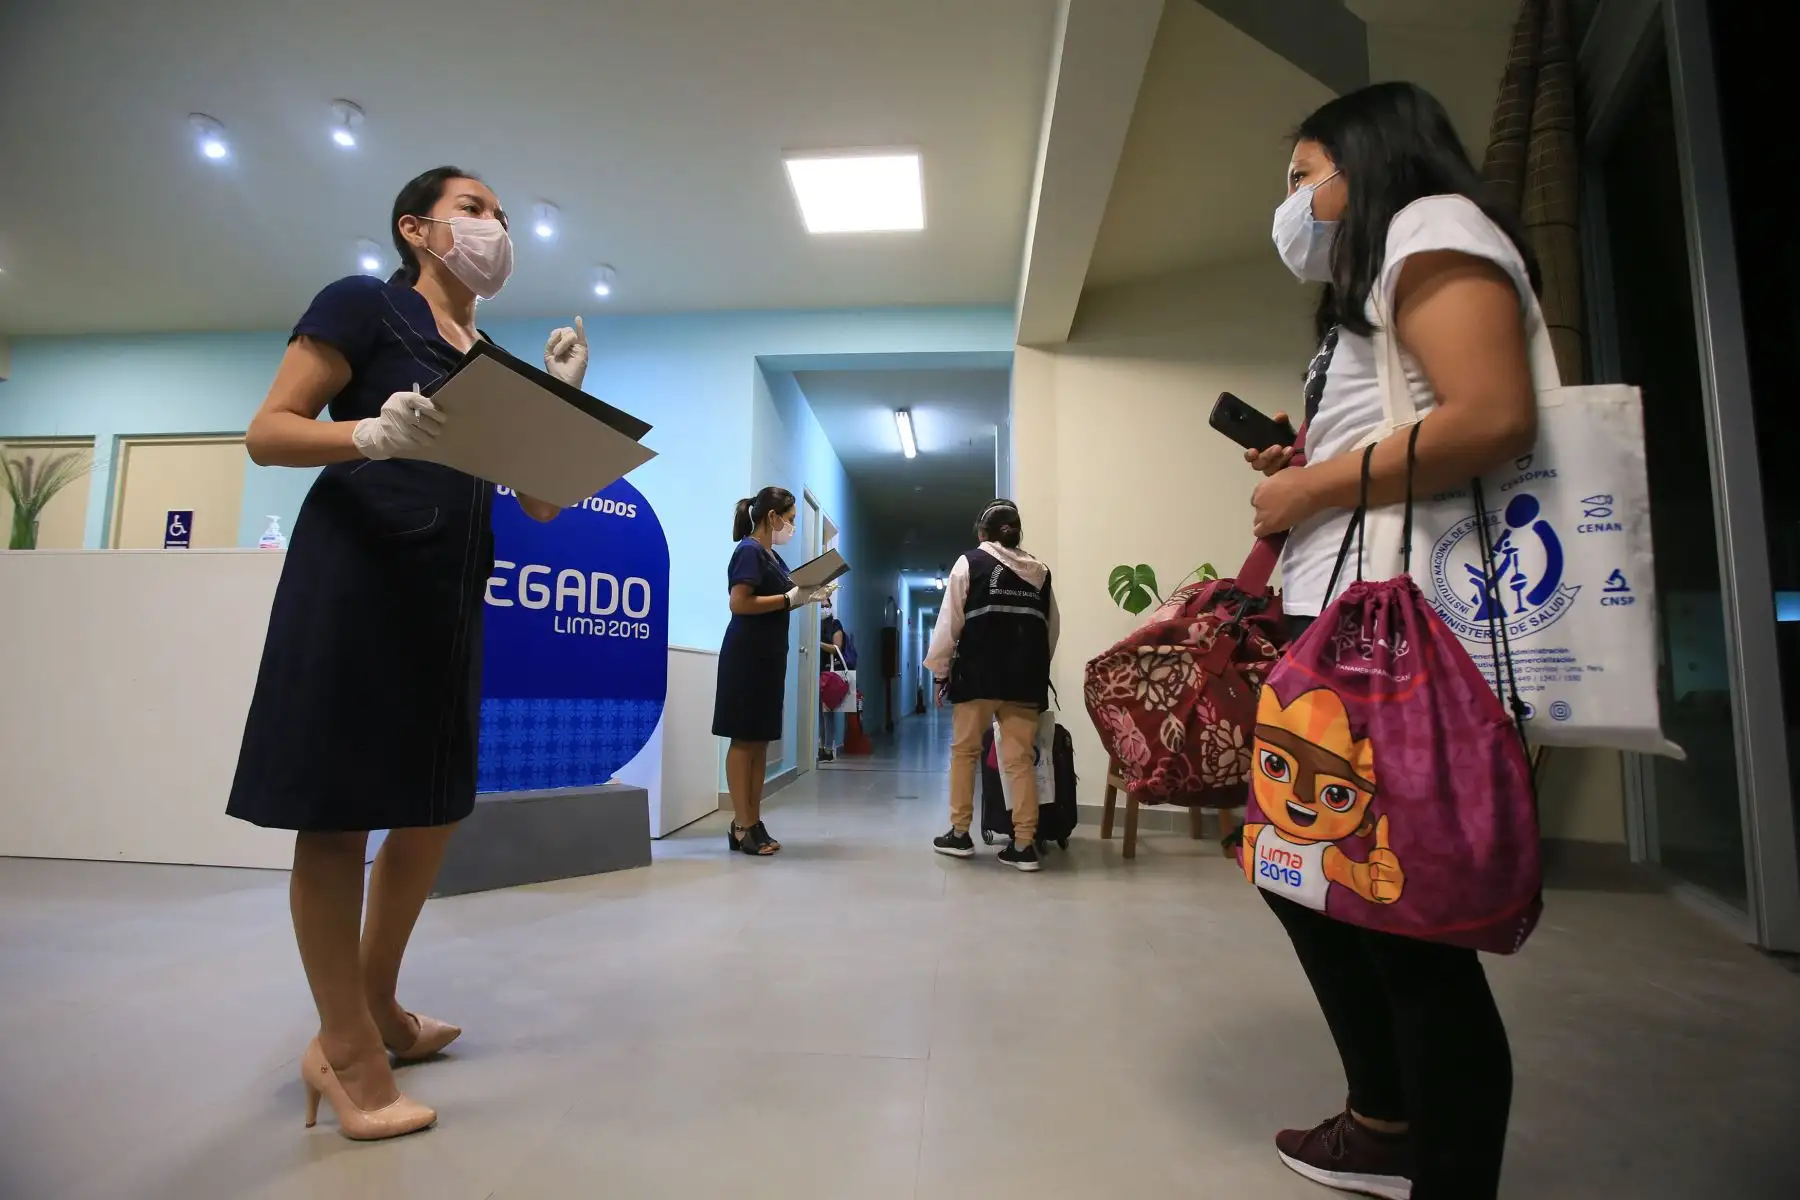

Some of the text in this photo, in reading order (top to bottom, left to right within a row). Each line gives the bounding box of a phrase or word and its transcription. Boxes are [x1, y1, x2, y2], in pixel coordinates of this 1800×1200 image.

[582, 496, 638, 519] TODOS
[1453, 526, 1466, 539] DE
[1577, 522, 1623, 534] CENAN
[1434, 539, 1453, 576] NACIONAL
[484, 560, 651, 619] EGADO
[1436, 577, 1470, 615] INSTITUTO
[1600, 596, 1636, 606] CNSP
[608, 620, 650, 640] 2019
[1437, 596, 1566, 639] MINISTERO DE SALUD
[1260, 860, 1302, 888] 2019
